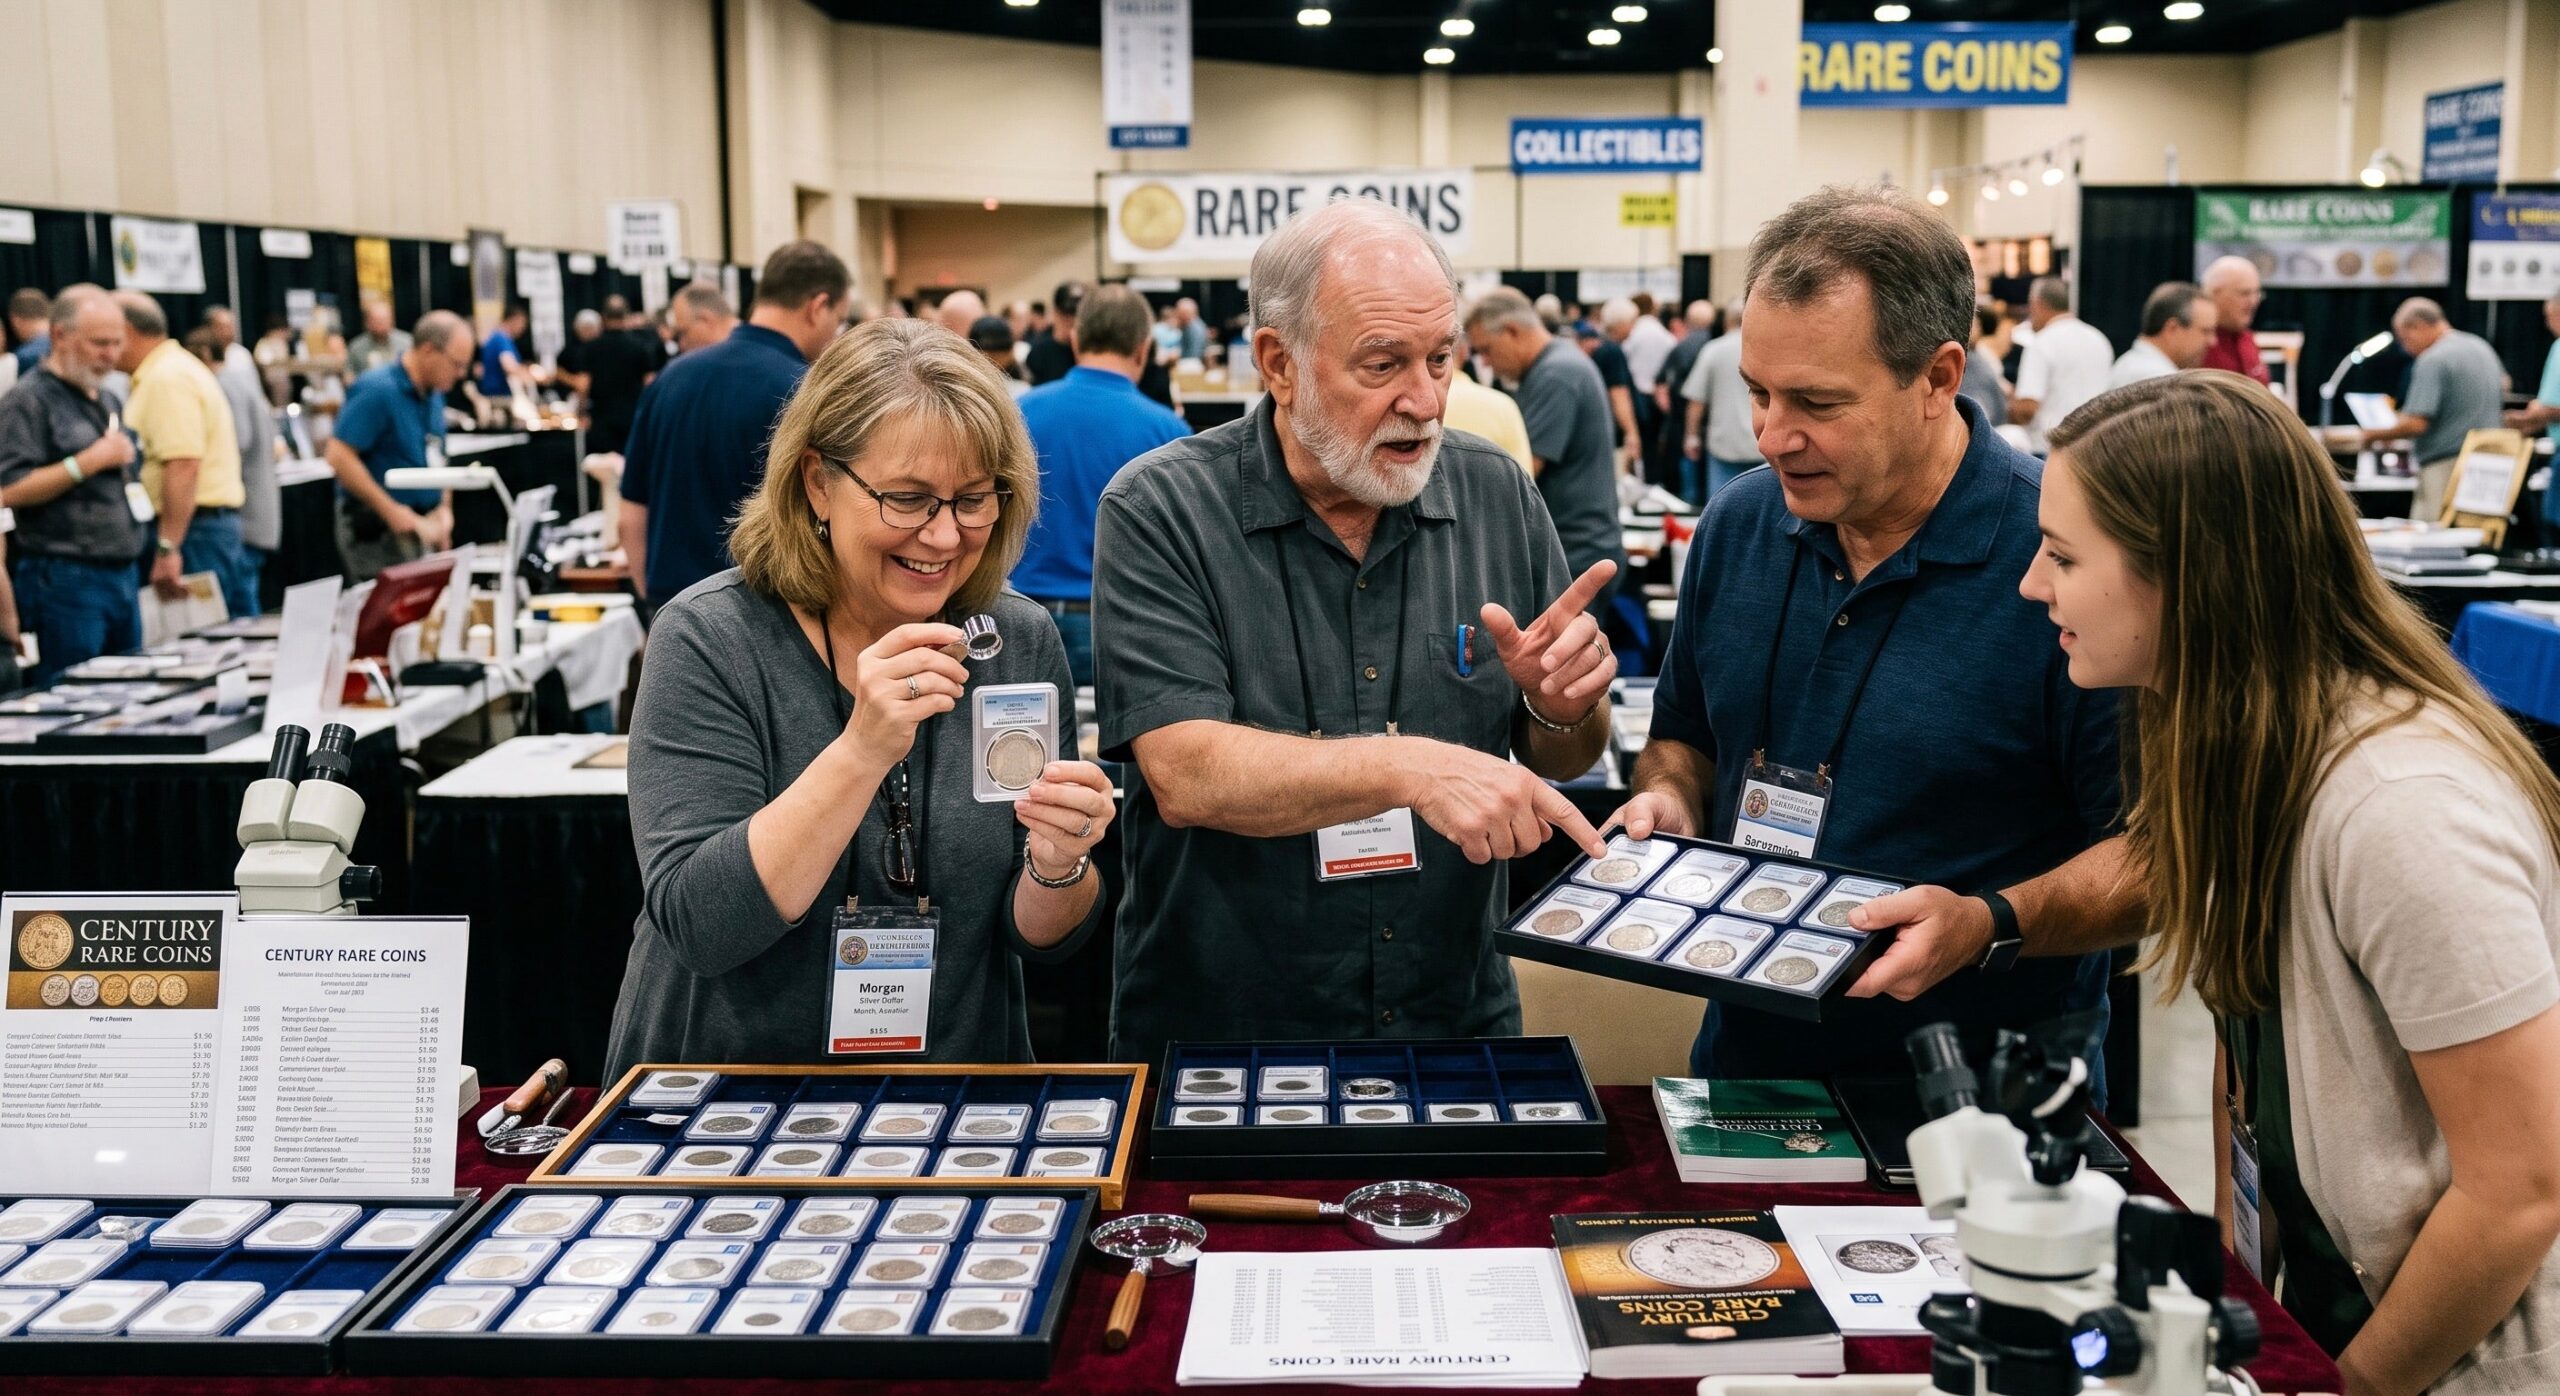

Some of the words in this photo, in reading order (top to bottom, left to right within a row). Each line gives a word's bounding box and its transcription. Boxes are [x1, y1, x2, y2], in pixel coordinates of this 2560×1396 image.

[1797, 40, 1912, 92] RARE
[1922, 40, 2062, 92] COINS
[1514, 129, 1700, 164] COLLECTIBLES
[80, 919, 216, 942] CENTURY
[80, 946, 137, 963] RARE
[143, 946, 212, 963] COINS
[265, 948, 334, 962] CENTURY
[338, 949, 376, 962] RARE
[381, 949, 427, 963] COINS
[859, 983, 904, 995] Morgan
[1619, 1301, 1705, 1314] COINS
[1712, 1297, 1783, 1310] RARE
[1640, 1309, 1770, 1325] CENTURY
[1269, 1356, 1335, 1366] COINS
[1343, 1356, 1400, 1365] RARE
[1409, 1355, 1511, 1365] CENTURY
